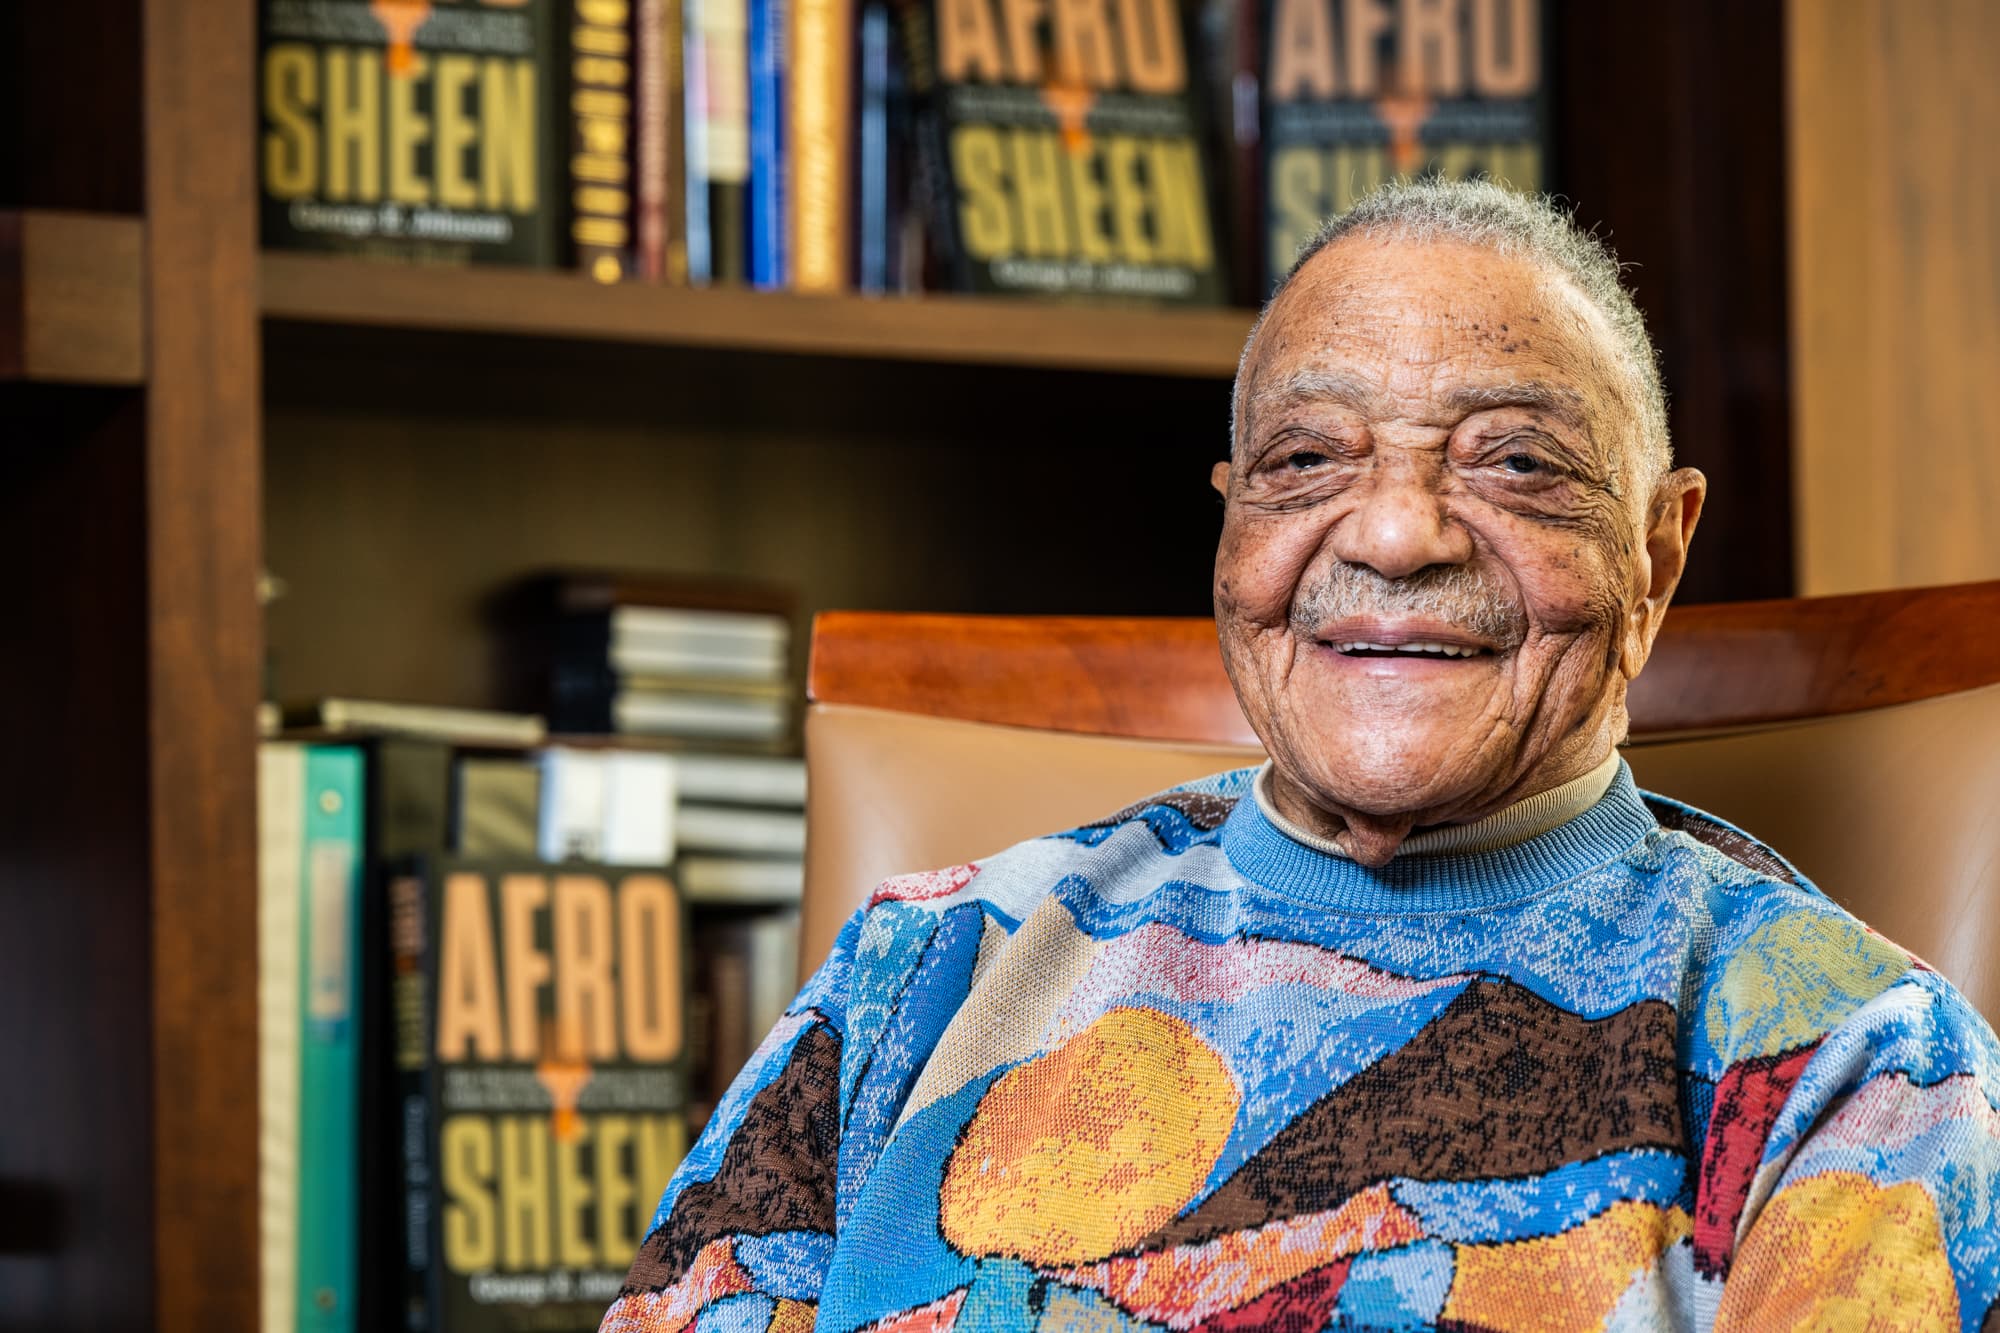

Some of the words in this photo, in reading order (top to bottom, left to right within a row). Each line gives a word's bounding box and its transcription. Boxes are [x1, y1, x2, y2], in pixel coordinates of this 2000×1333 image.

[265, 43, 537, 213] SHEEN
[955, 127, 1213, 271] SHEEN
[437, 873, 682, 1061] AFRO
